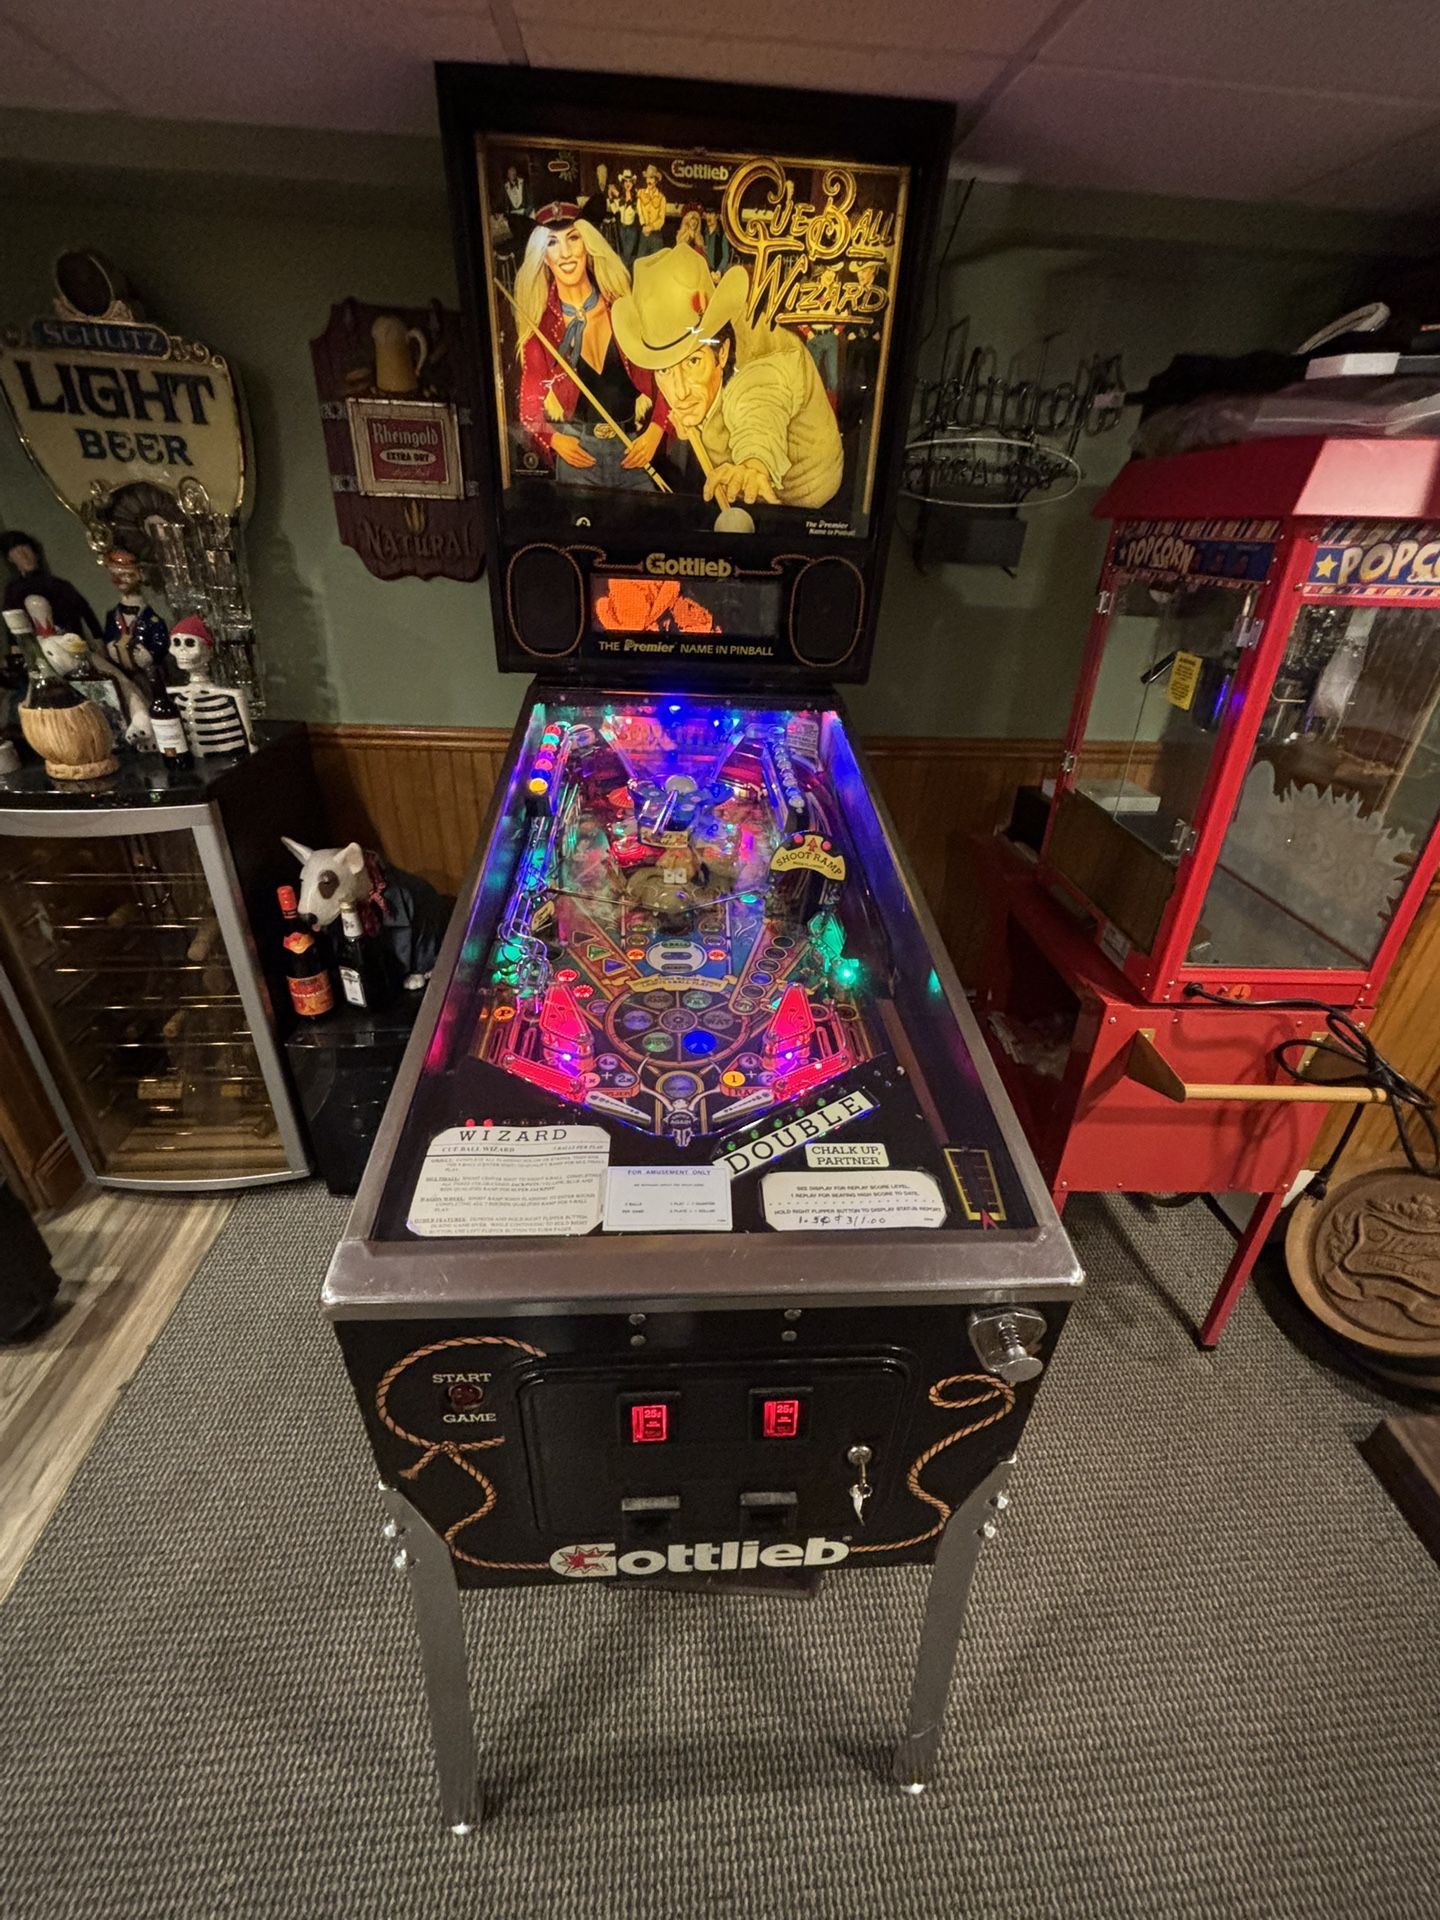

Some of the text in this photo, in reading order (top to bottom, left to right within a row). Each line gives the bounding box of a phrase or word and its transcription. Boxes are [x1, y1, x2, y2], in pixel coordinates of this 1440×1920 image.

[671, 159, 729, 181] Gottlieb
[746, 235, 888, 331] WIZARD
[14, 360, 215, 425] LIGHT
[75, 428, 193, 466] BEER
[373, 422, 438, 448] Rheingold
[386, 452, 429, 461] EXTRA DRY
[646, 553, 731, 577] Gottlieb
[1126, 536, 1196, 574] POPCORN
[1337, 539, 1440, 585] POPC
[599, 639, 774, 656] THE Premier NAME IN PINBALL
[776, 851, 842, 875] SHOOT RAMP
[460, 1129, 567, 1142] WIZARD
[724, 1096, 862, 1175] DOUBLE
[811, 1146, 881, 1156] CHALK UP,
[817, 1156, 880, 1165] PARTNER
[432, 1373, 492, 1384] START
[443, 1413, 496, 1423] GAME
[549, 1537, 849, 1578] Gottlieb
